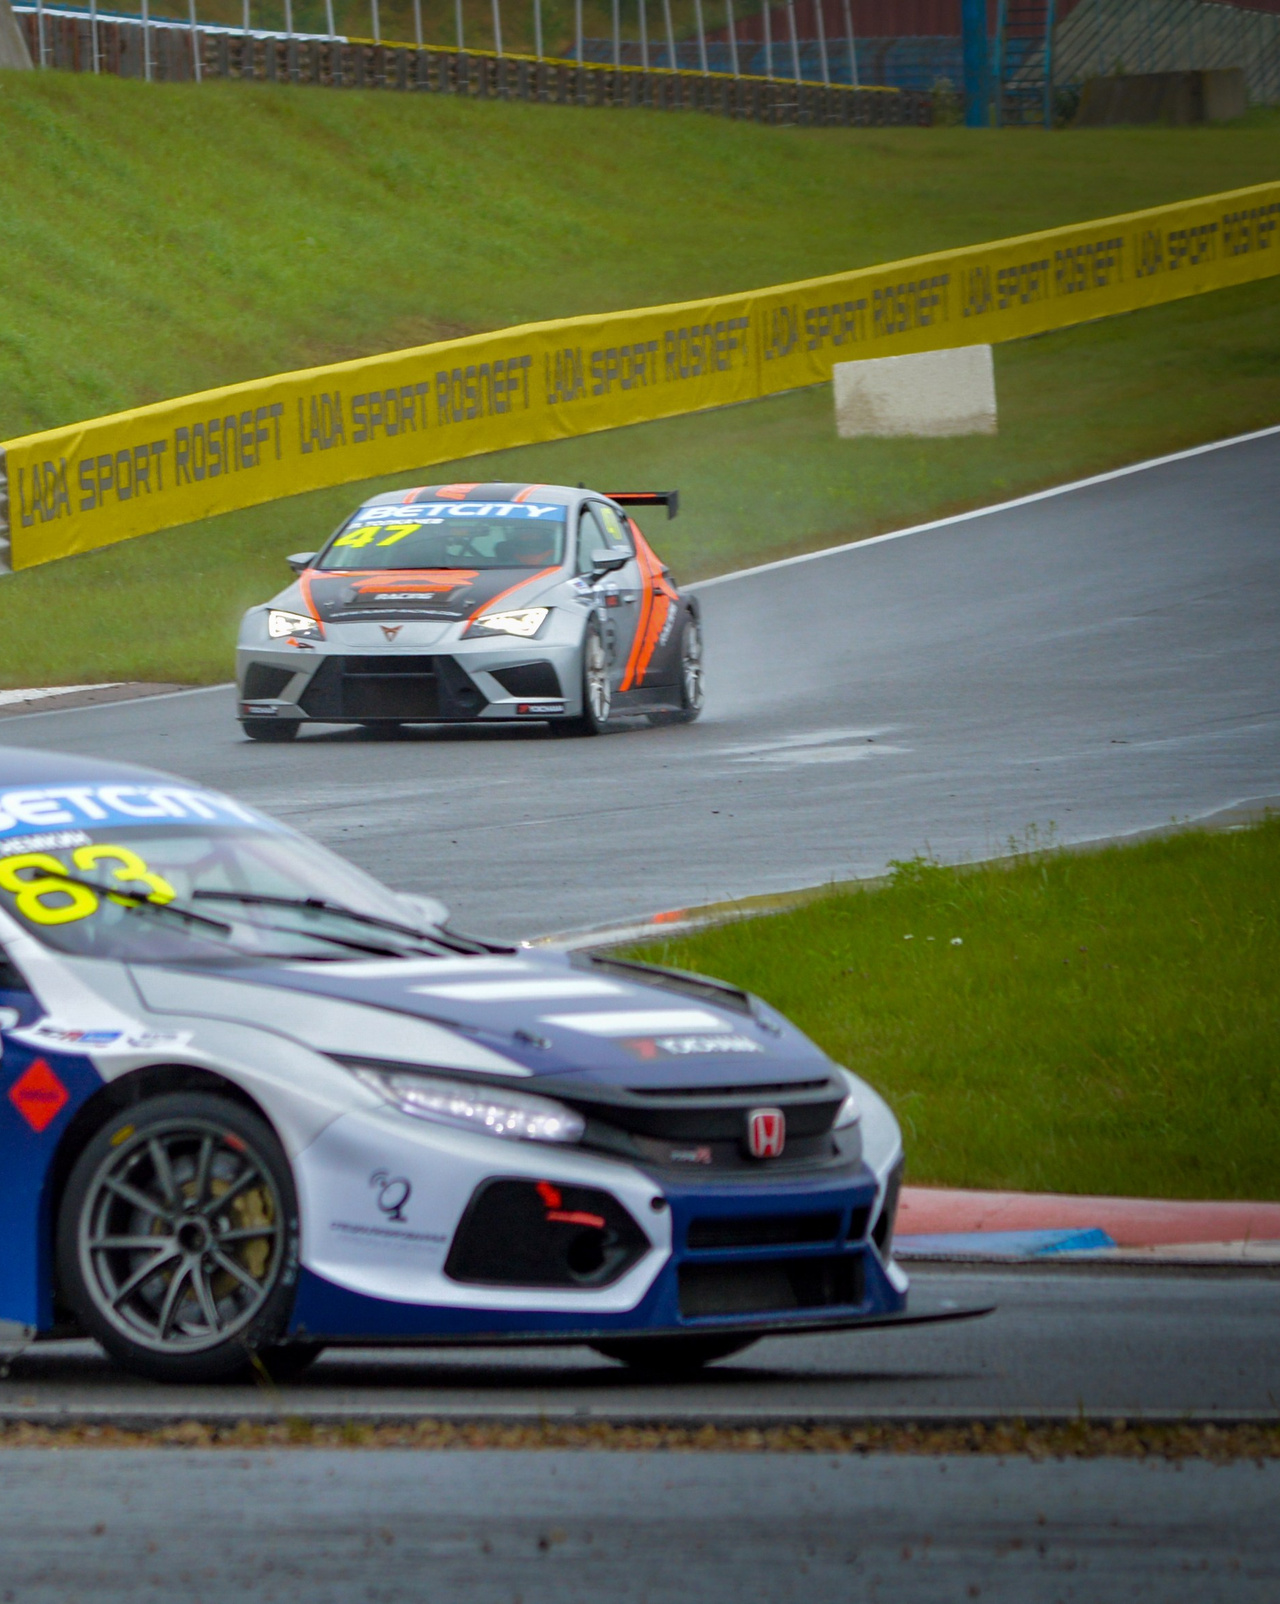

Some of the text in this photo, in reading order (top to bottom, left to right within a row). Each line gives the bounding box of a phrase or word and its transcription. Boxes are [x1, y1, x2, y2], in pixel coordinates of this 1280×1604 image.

[18, 457, 72, 528] LADA
[79, 440, 168, 512] SPORT
[174, 402, 285, 487] ROSNEFT
[298, 390, 347, 454] LADA
[352, 381, 430, 443] SPORT
[436, 355, 533, 428] ROSNEFT
[545, 346, 587, 405] LADA
[592, 340, 659, 396] SPORT
[665, 316, 760, 382] ROSNEFT
[762, 304, 801, 361] LADA
[806, 299, 869, 350] SPORT
[998, 259, 1050, 310] SPORT
[361, 503, 558, 521] BETCITY
[333, 524, 422, 548] 47
